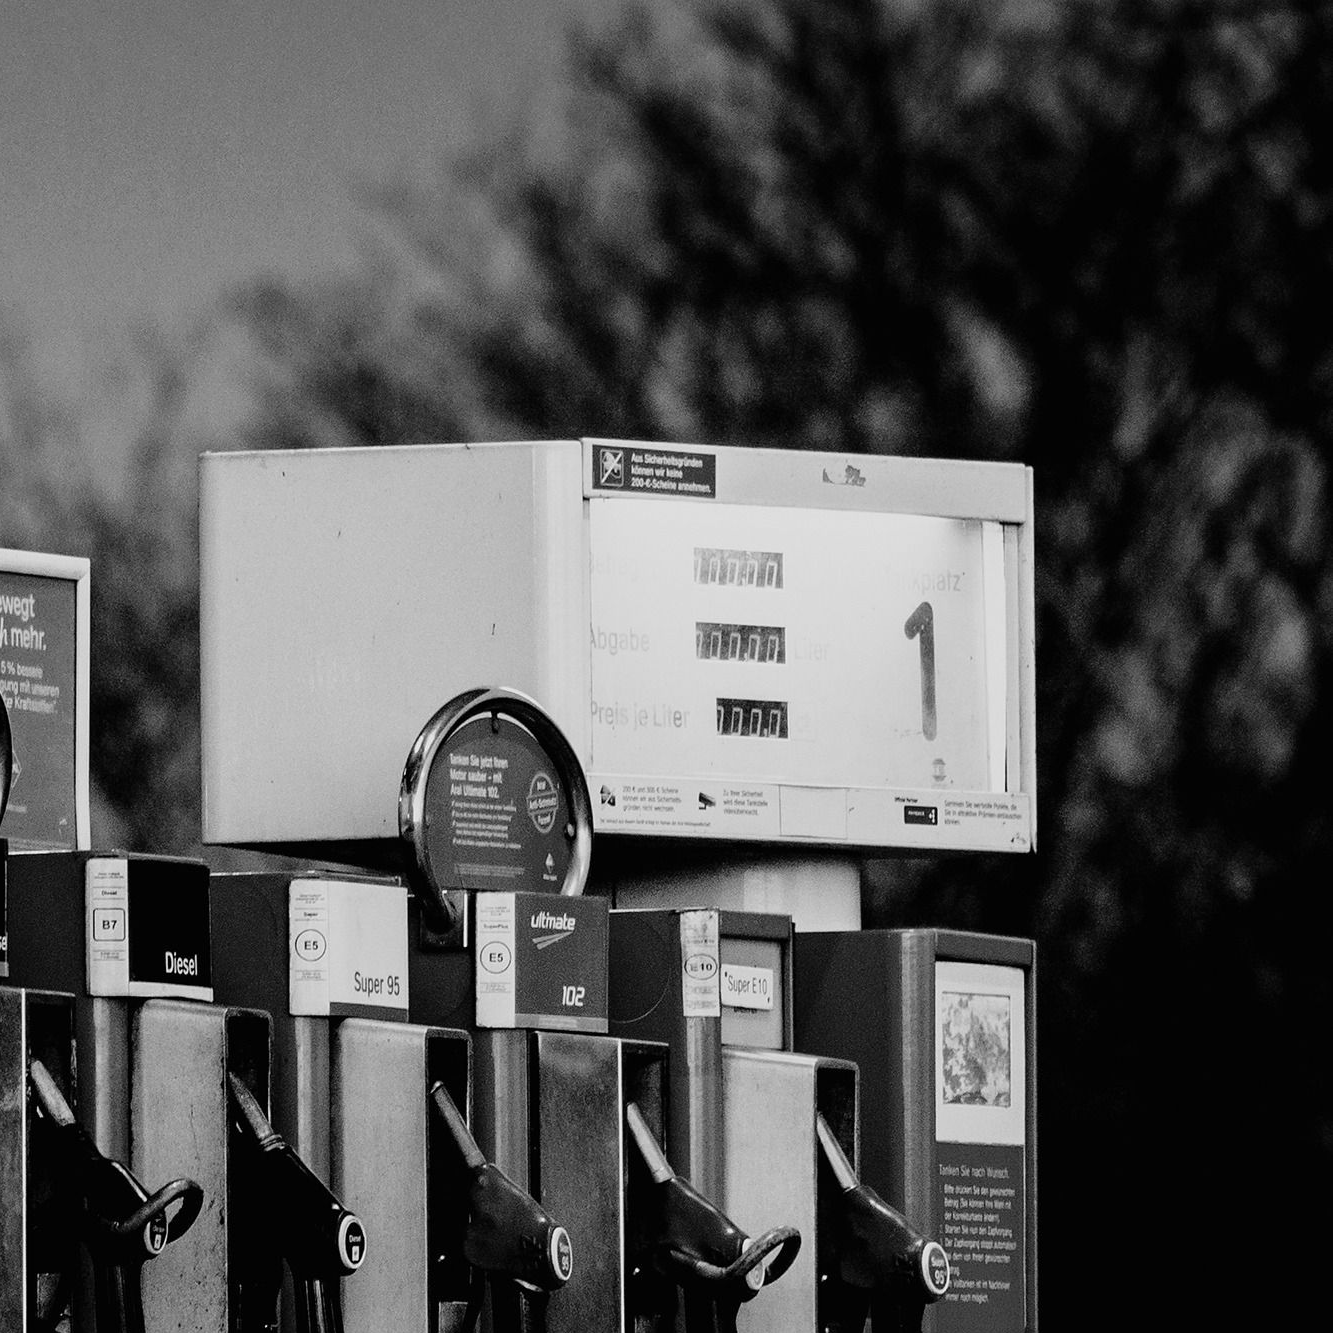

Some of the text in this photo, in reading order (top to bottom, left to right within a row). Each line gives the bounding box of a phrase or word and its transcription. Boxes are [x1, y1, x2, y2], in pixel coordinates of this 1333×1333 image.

[631, 452, 703, 468] Aus Sicherheitsgründen
[631, 465, 683, 479] können wir keine
[11, 624, 47, 650] mehr.
[902, 600, 937, 742] 1
[591, 699, 690, 730] Preis je Liter
[451, 783, 462, 796] Aral
[463, 784, 487, 798] Ultimate
[102, 920, 117, 930] B7
[531, 911, 576, 931] ultimate
[305, 941, 319, 950] E5
[165, 951, 198, 976] Diesel
[489, 953, 503, 962] E5
[355, 972, 400, 998] Super 95
[728, 975, 750, 995] Super
[563, 986, 585, 1007] 102
[939, 1164, 959, 1176] Tanken
[961, 1164, 970, 1177] Sie
[971, 1166, 985, 1178] nach
[935, 1269, 945, 1285] 95
